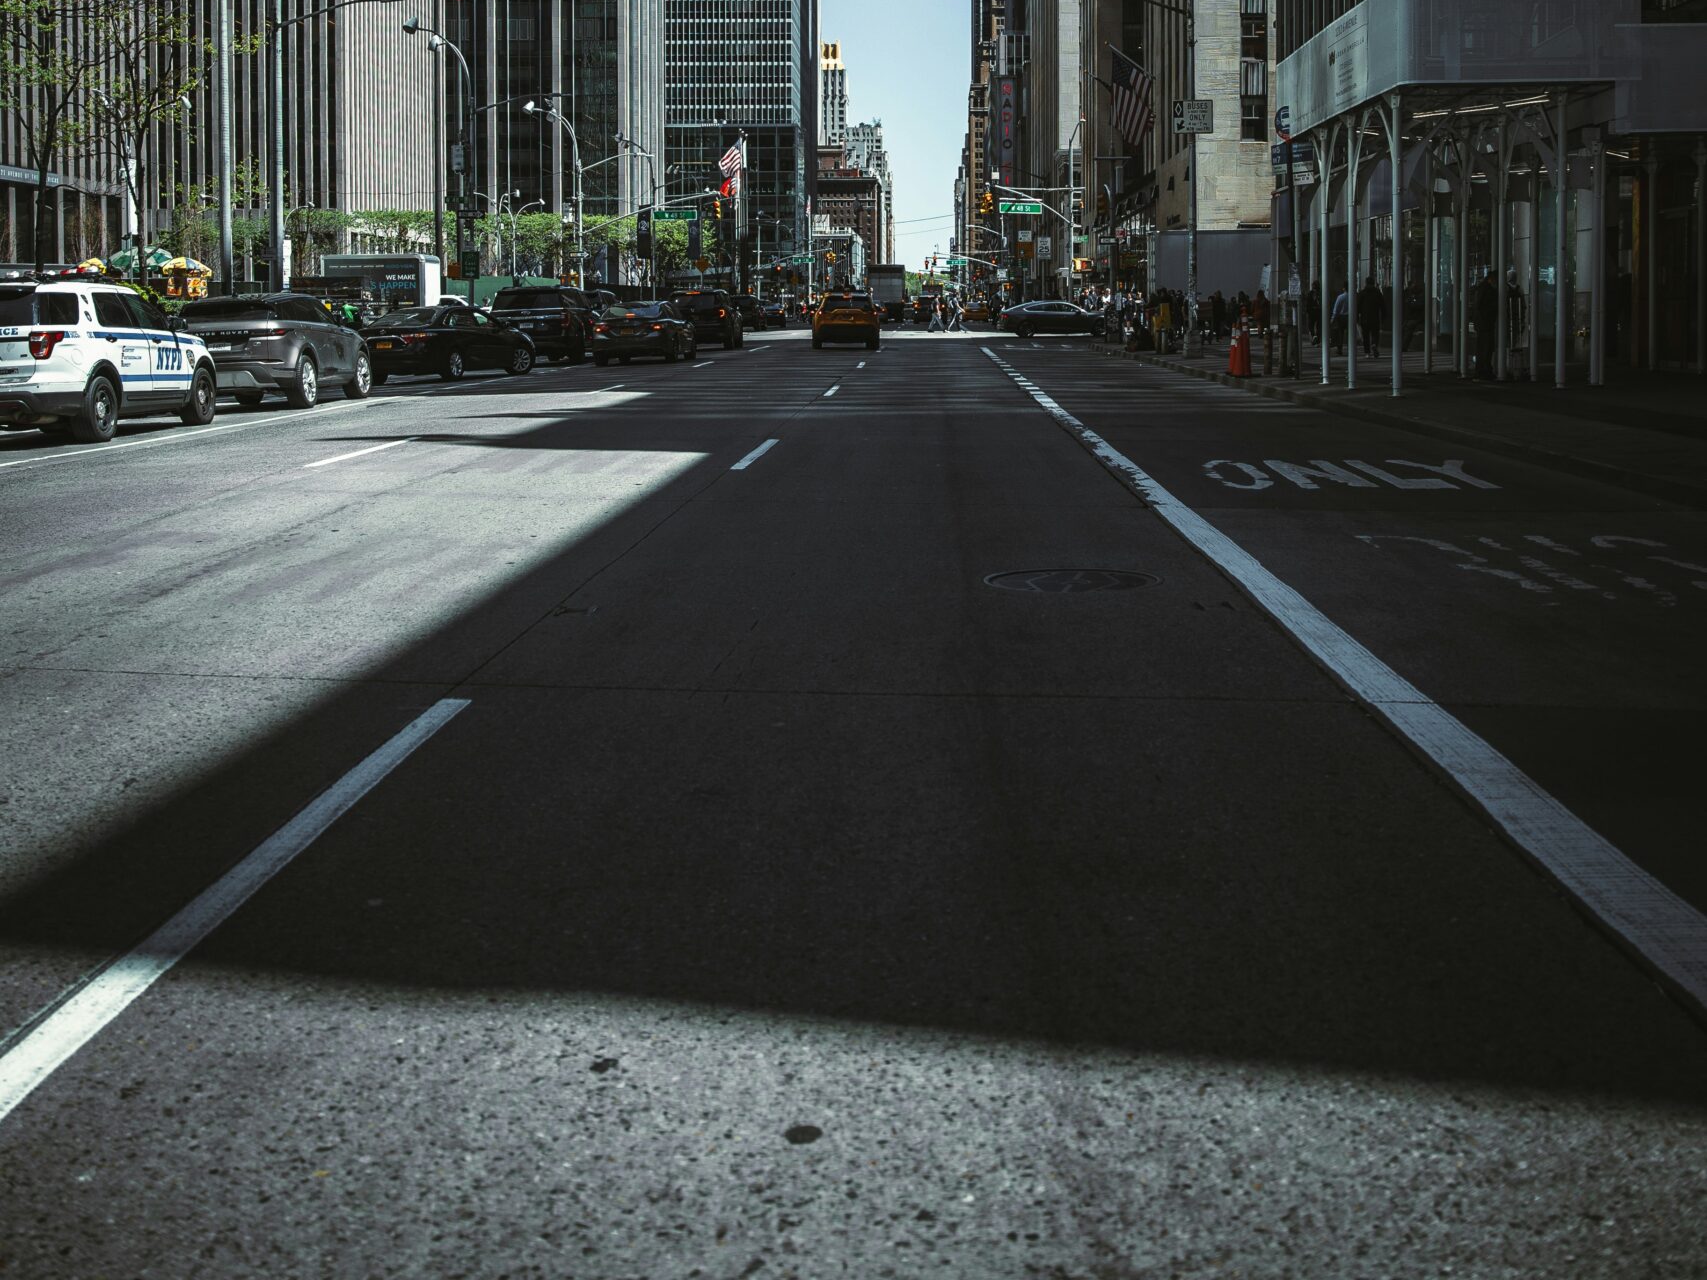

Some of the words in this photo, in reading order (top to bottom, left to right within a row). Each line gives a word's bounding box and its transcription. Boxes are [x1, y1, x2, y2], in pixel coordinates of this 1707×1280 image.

[1001, 83, 1013, 150] RADIO
[1187, 102, 1208, 110] BUSES
[380, 281, 417, 289] HAPPEN
[156, 347, 183, 371] NYPD
[1202, 458, 1504, 491] ONLY
